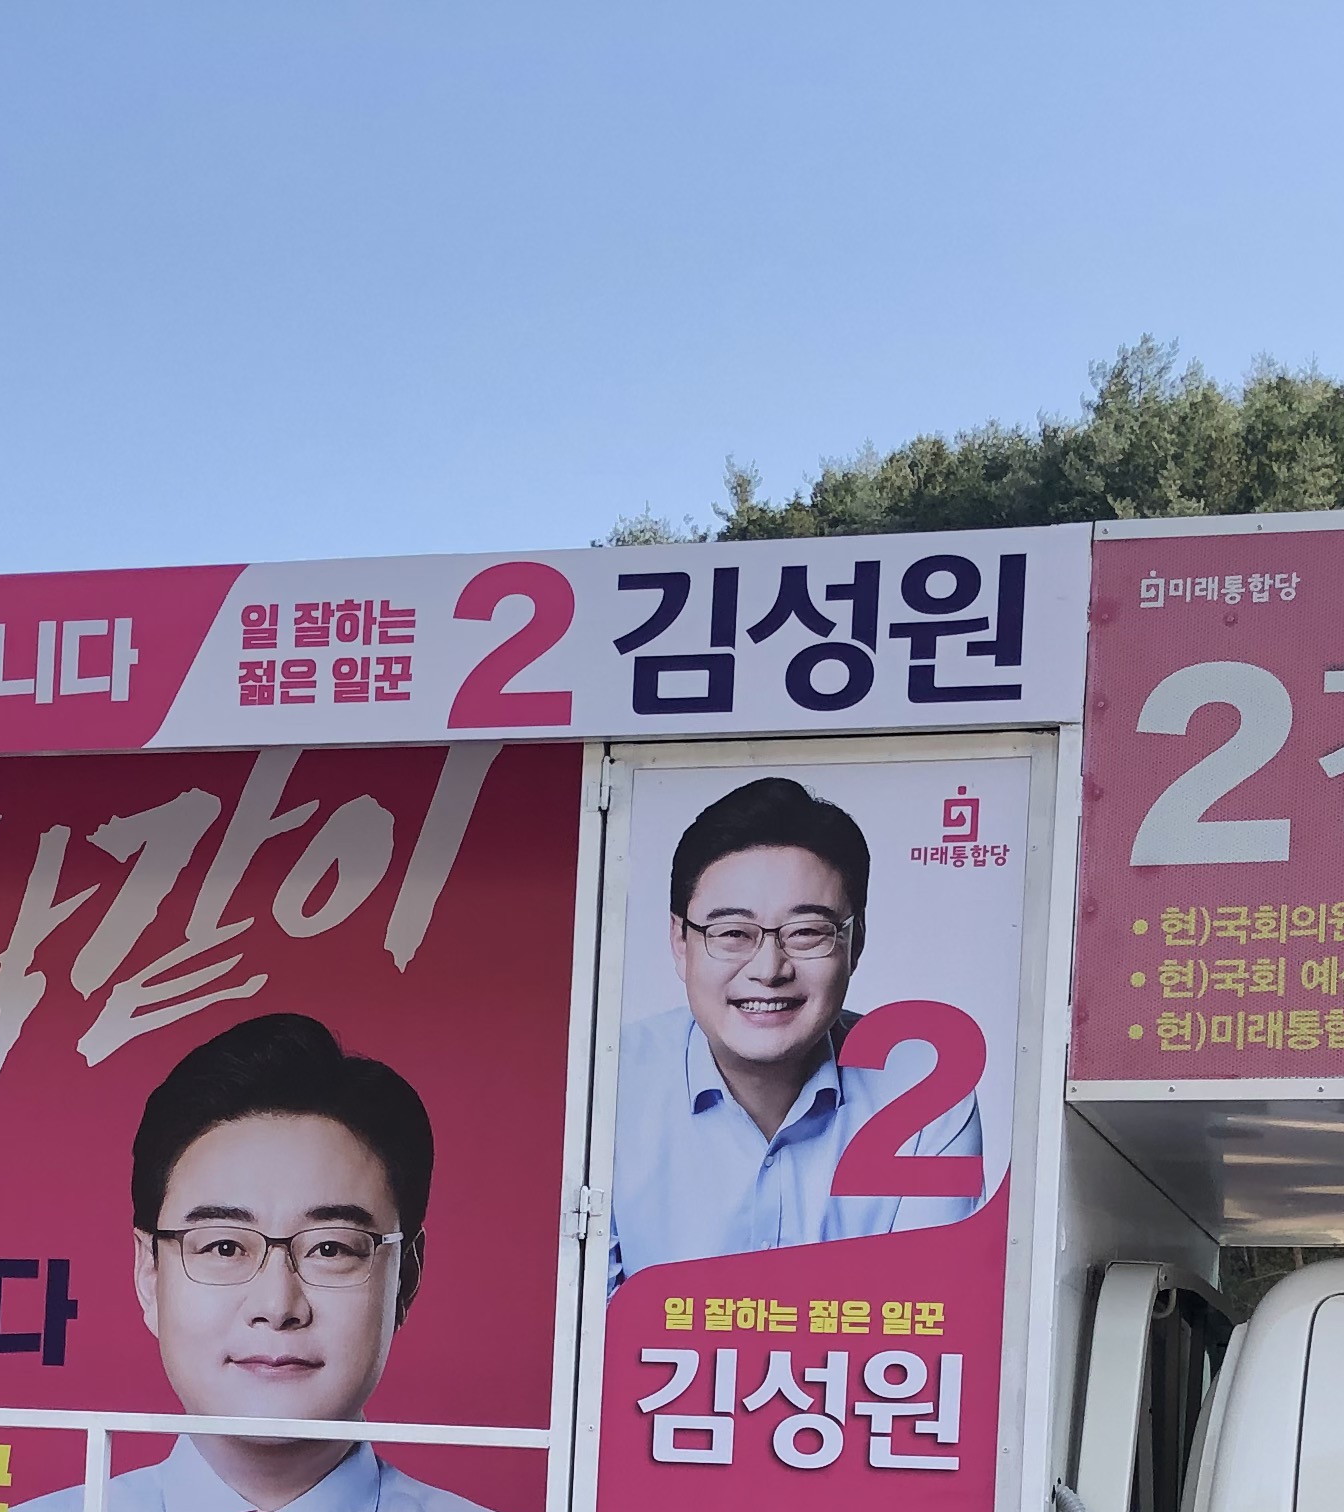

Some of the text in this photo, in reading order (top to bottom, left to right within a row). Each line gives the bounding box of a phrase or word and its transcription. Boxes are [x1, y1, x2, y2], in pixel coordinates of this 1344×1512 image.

[1169, 571, 1302, 606] 미래통합당
[238, 599, 416, 650] 일 잘하는
[447, 552, 1028, 730] 2 김성원
[238, 655, 413, 708] 젊은 일꾼
[1129, 659, 1294, 868] 2
[910, 844, 1011, 869] 미래통합당
[1157, 956, 1287, 1002] 현)국회
[830, 999, 987, 1199] 2
[663, 1296, 947, 1337] 일 잘하는 젊은 일꾼
[637, 1346, 966, 1473] 김성원
